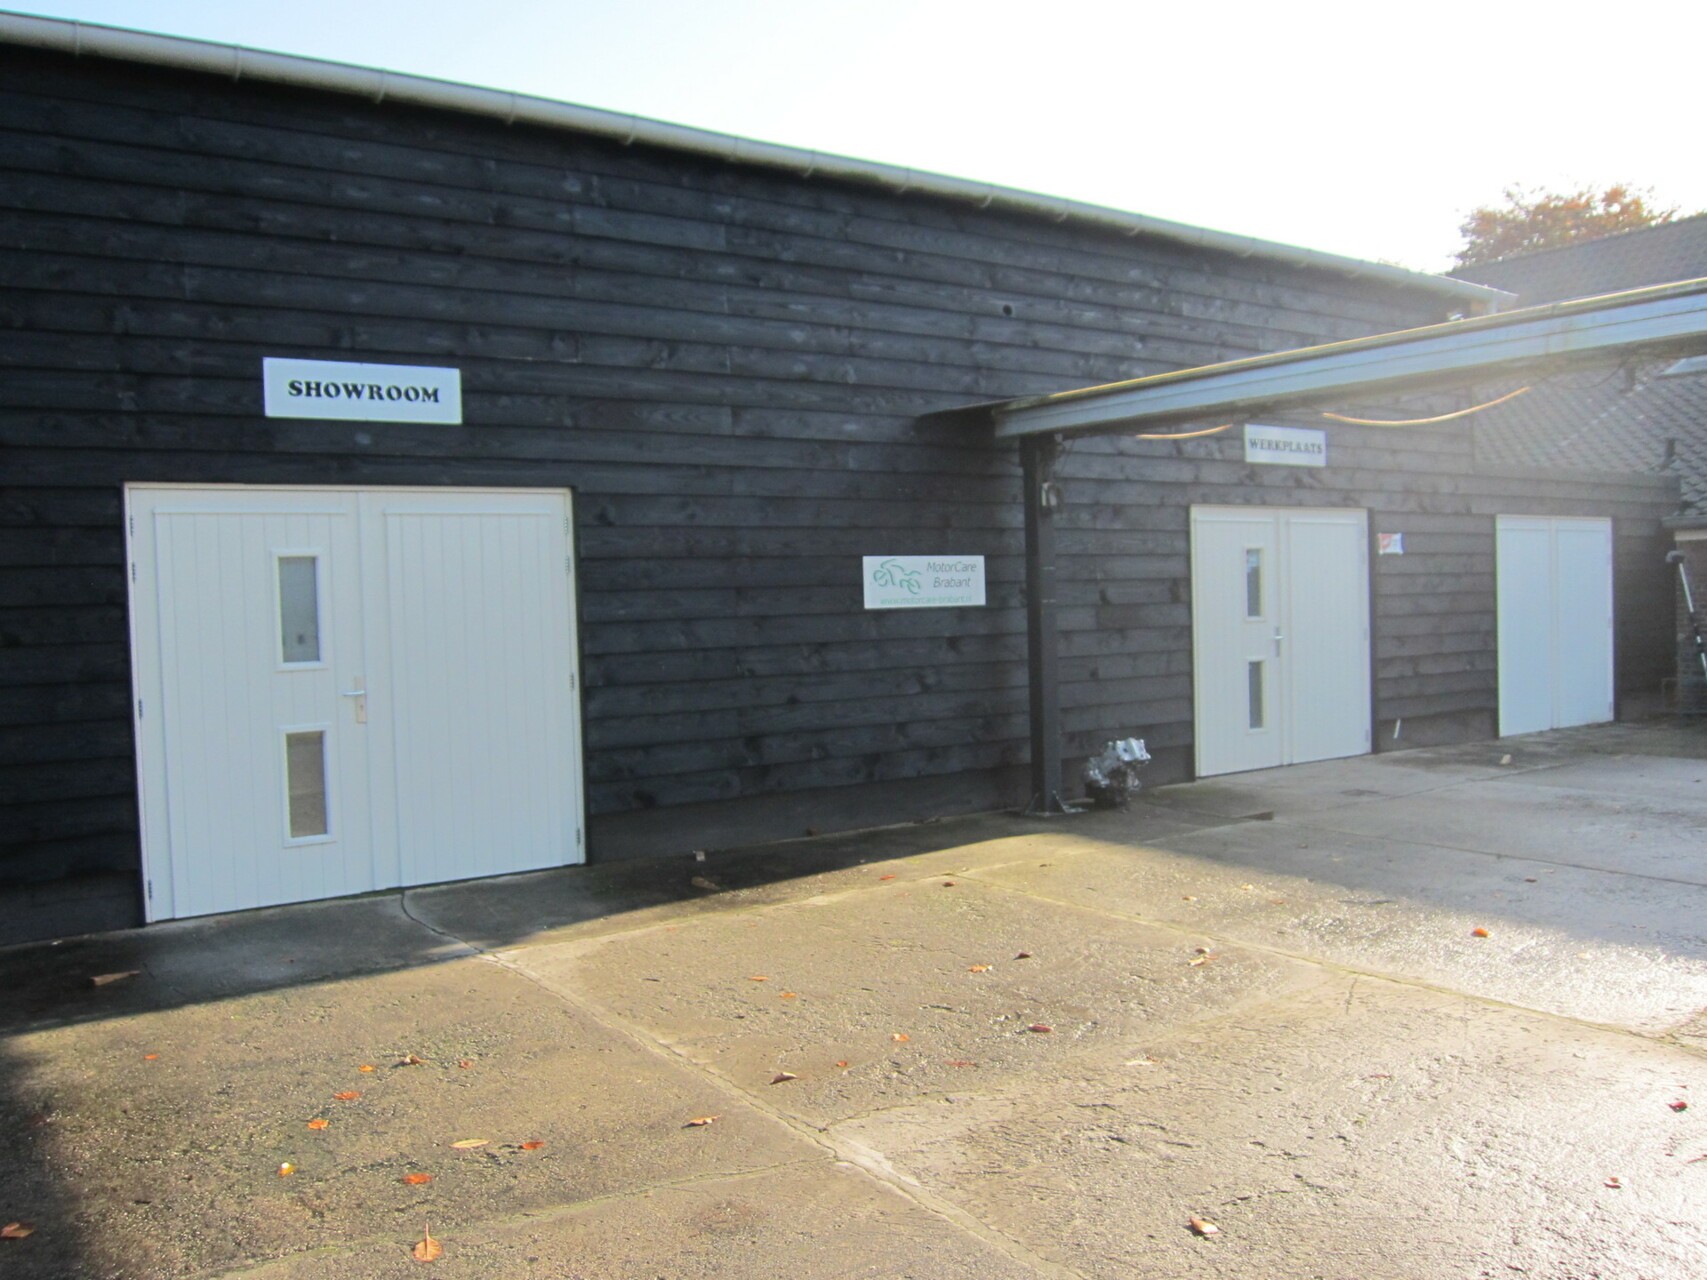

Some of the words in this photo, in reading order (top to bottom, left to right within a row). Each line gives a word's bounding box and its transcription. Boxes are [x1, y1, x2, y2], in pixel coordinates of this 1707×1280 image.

[288, 379, 440, 403] SHOWROOM
[1249, 438, 1323, 454] WERKPLAATS
[926, 561, 977, 573] MotorCare
[933, 577, 971, 588] Brabant
